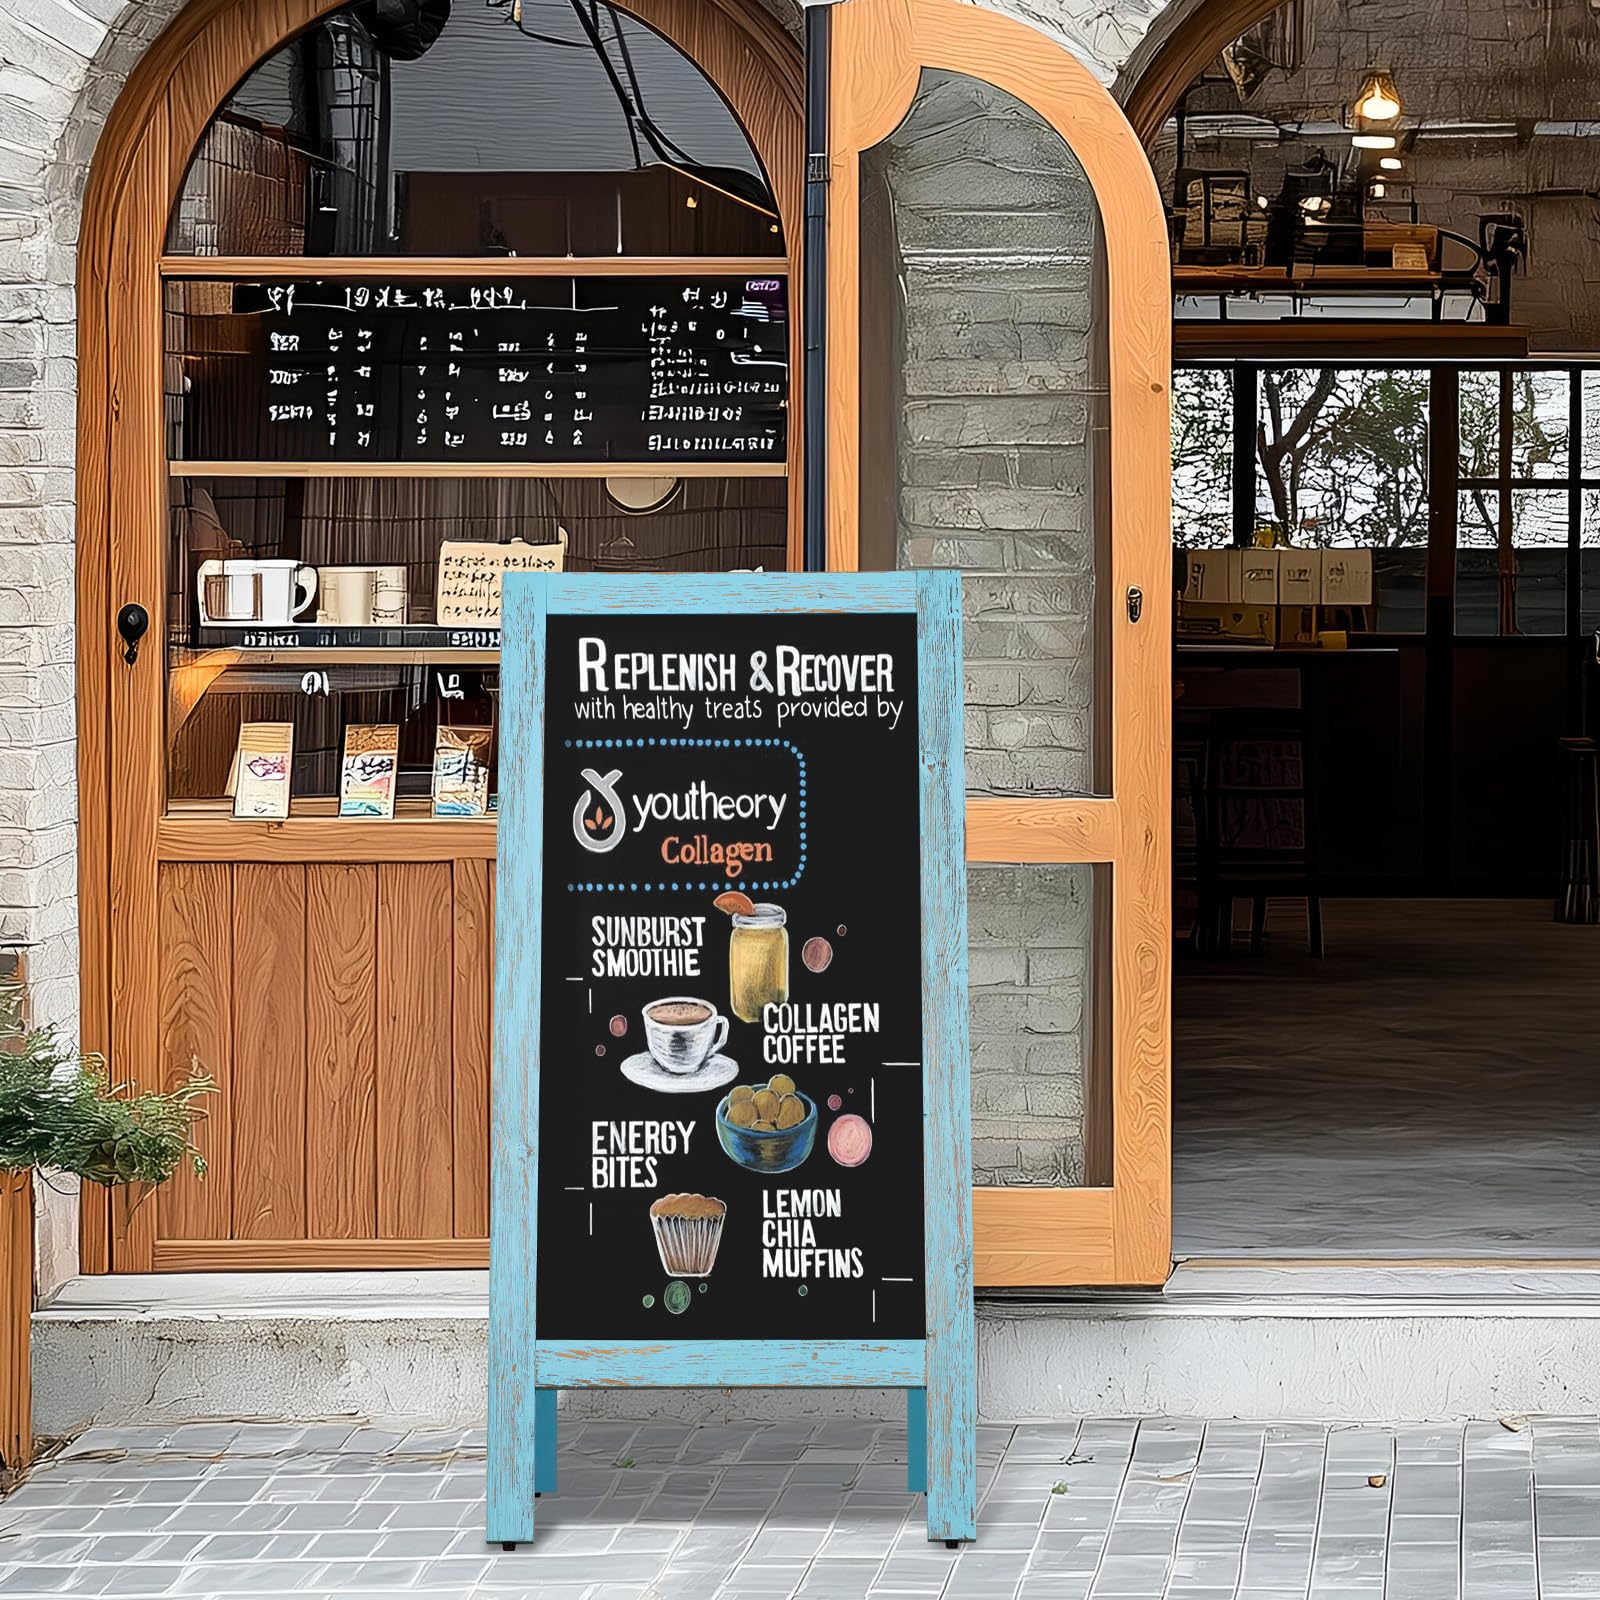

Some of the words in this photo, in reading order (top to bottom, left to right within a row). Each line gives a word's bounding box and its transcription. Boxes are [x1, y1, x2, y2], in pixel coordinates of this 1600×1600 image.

[579, 638, 735, 692] REPLENISH
[575, 695, 615, 719] with
[623, 695, 693, 729] healthy
[705, 696, 762, 719] treats
[778, 692, 867, 728] provided
[878, 694, 903, 730] by
[633, 780, 786, 832] youtheory
[661, 835, 772, 877] Collagen
[592, 916, 706, 946] SUNBURST
[592, 949, 700, 977] SMOOTHIE
[763, 1003, 880, 1033] COLLAGEN
[764, 1035, 845, 1064] COFFEE
[592, 1121, 696, 1155] ENERGY
[592, 1156, 657, 1188] BITES
[763, 1189, 841, 1218] LEMON
[763, 1219, 816, 1248] CHIA
[763, 1247, 863, 1278] MUFFINS
